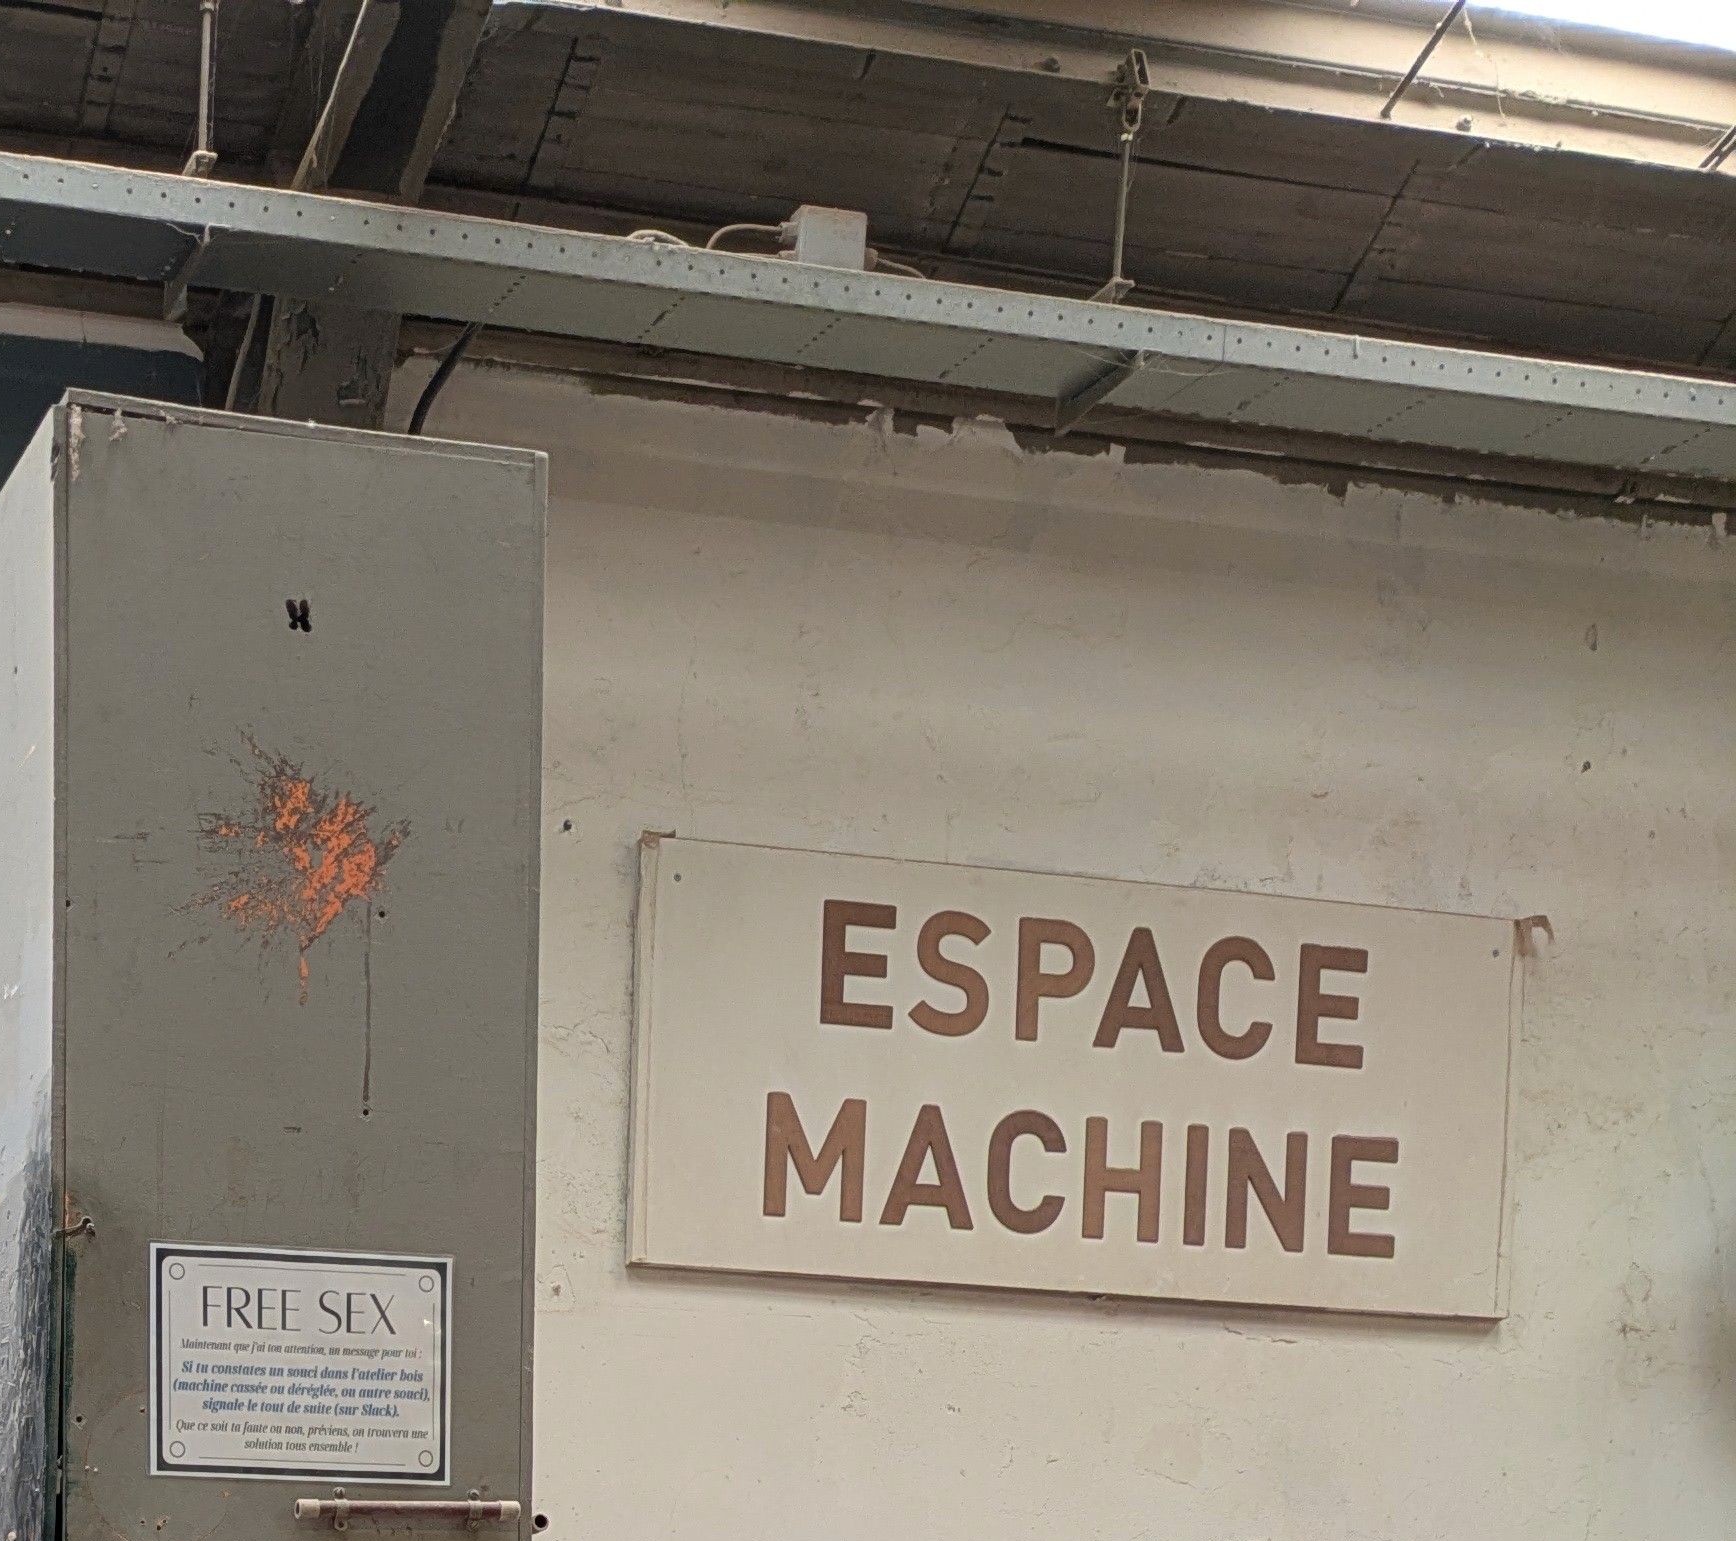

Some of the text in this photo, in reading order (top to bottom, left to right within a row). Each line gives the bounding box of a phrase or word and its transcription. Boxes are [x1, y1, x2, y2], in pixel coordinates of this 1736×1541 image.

[819, 899, 1369, 1069] ESPACE
[762, 1091, 1400, 1259] MACHINE
[202, 1285, 397, 1335] FREE SEX
[342, 1348, 379, 1360] message
[181, 1360, 193, 1373] Si
[195, 1363, 209, 1374] tu
[211, 1364, 267, 1377] constates
[268, 1367, 284, 1377] un
[286, 1366, 318, 1379] souci
[320, 1366, 349, 1380] dans
[399, 1368, 424, 1382] bois
[172, 1378, 228, 1393] (machine
[230, 1382, 268, 1395] cassée
[270, 1385, 285, 1395] ou
[341, 1388, 356, 1398] ou
[358, 1388, 392, 1399] autre
[202, 1397, 400, 1418] signale le tout de suite (sur Slack).
[175, 1419, 196, 1433] Que
[197, 1422, 209, 1431] ce
[210, 1420, 229, 1432] soit
[244, 1438, 283, 1451] solution
[285, 1440, 306, 1451] tous
[308, 1441, 353, 1453] ensemble
